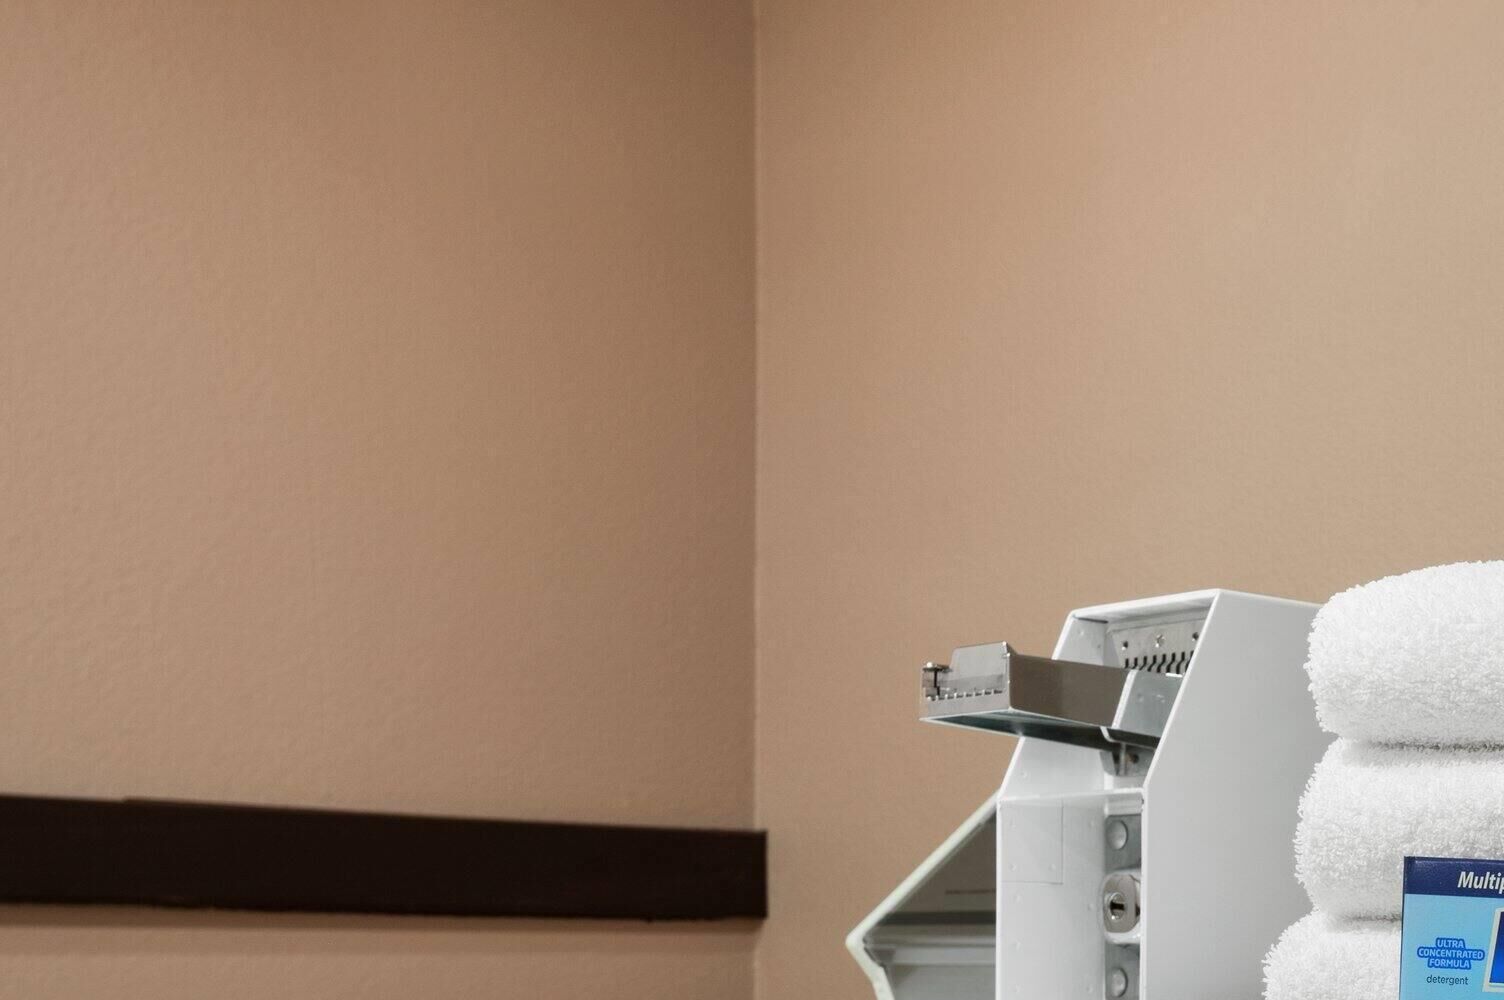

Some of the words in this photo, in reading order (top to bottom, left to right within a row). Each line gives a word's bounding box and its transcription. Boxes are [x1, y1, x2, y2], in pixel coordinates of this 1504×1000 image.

[1436, 939, 1465, 949] ULTRA
[1418, 947, 1484, 960] CONCENTRATED
[1427, 958, 1470, 969] FORMULA
[1426, 974, 1469, 986] detergent
